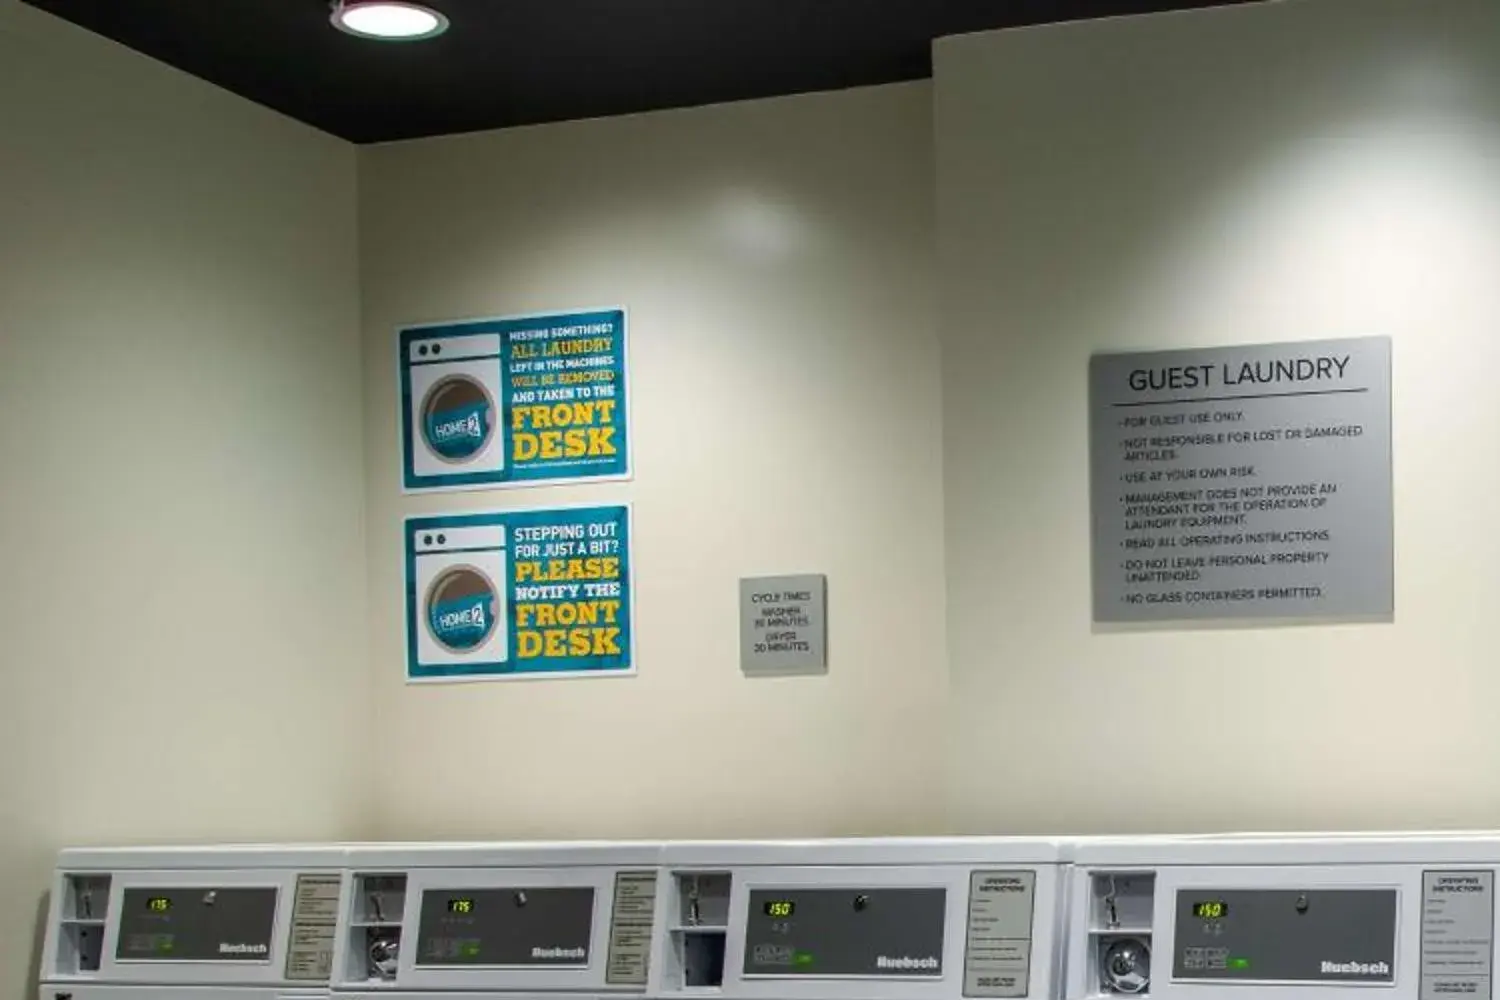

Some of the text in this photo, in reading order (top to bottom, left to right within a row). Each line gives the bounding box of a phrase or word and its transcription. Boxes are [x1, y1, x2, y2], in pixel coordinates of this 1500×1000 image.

[551, 322, 613, 338] SOMETHING?
[511, 337, 613, 358] ALL LAUNDRY
[510, 355, 615, 373] LEFT IN THE MACHINES
[1128, 355, 1350, 391] GUEST LAUNDRY
[511, 375, 538, 387] WILL
[558, 369, 615, 384] REMOVED
[512, 385, 615, 402] AND TAKEN TO THE
[511, 399, 616, 429] FRONT
[1124, 416, 1147, 428] FOR
[1149, 414, 1185, 426] GUEST
[1189, 412, 1212, 424] USE
[512, 426, 617, 460] DESK
[1124, 425, 1363, 449] NOT RESPONSIBLE FOR LOST OR DAMAGED
[1125, 471, 1146, 483] USE
[1164, 468, 1197, 481] YOUR
[1199, 467, 1227, 479] OWN
[1125, 483, 1337, 503] MANAGEMENT DOES NOT PROVIDE AN
[1125, 497, 1327, 516] ATTENDANT FOR THE OPERATION OF
[514, 521, 617, 542] STEPPING OUT
[1125, 517, 1177, 530] LAUNDRY
[515, 540, 619, 558] FOR JUST A BIT?
[1125, 538, 1156, 549] READ
[1158, 536, 1176, 547] ALL
[1180, 533, 1243, 547] OPERATING
[515, 556, 619, 582] PLEASE
[1125, 551, 1329, 570] DO NOT LEAVE PERSONAL PROPERTY
[515, 582, 620, 600] NOTIFY THE
[1125, 593, 1143, 604] NO
[1145, 591, 1182, 604] GLASS
[1184, 588, 1255, 602] CONTAINERS
[515, 600, 619, 627] FRONT
[517, 627, 621, 657] DESK
[1320, 960, 1389, 974] Huebsch
